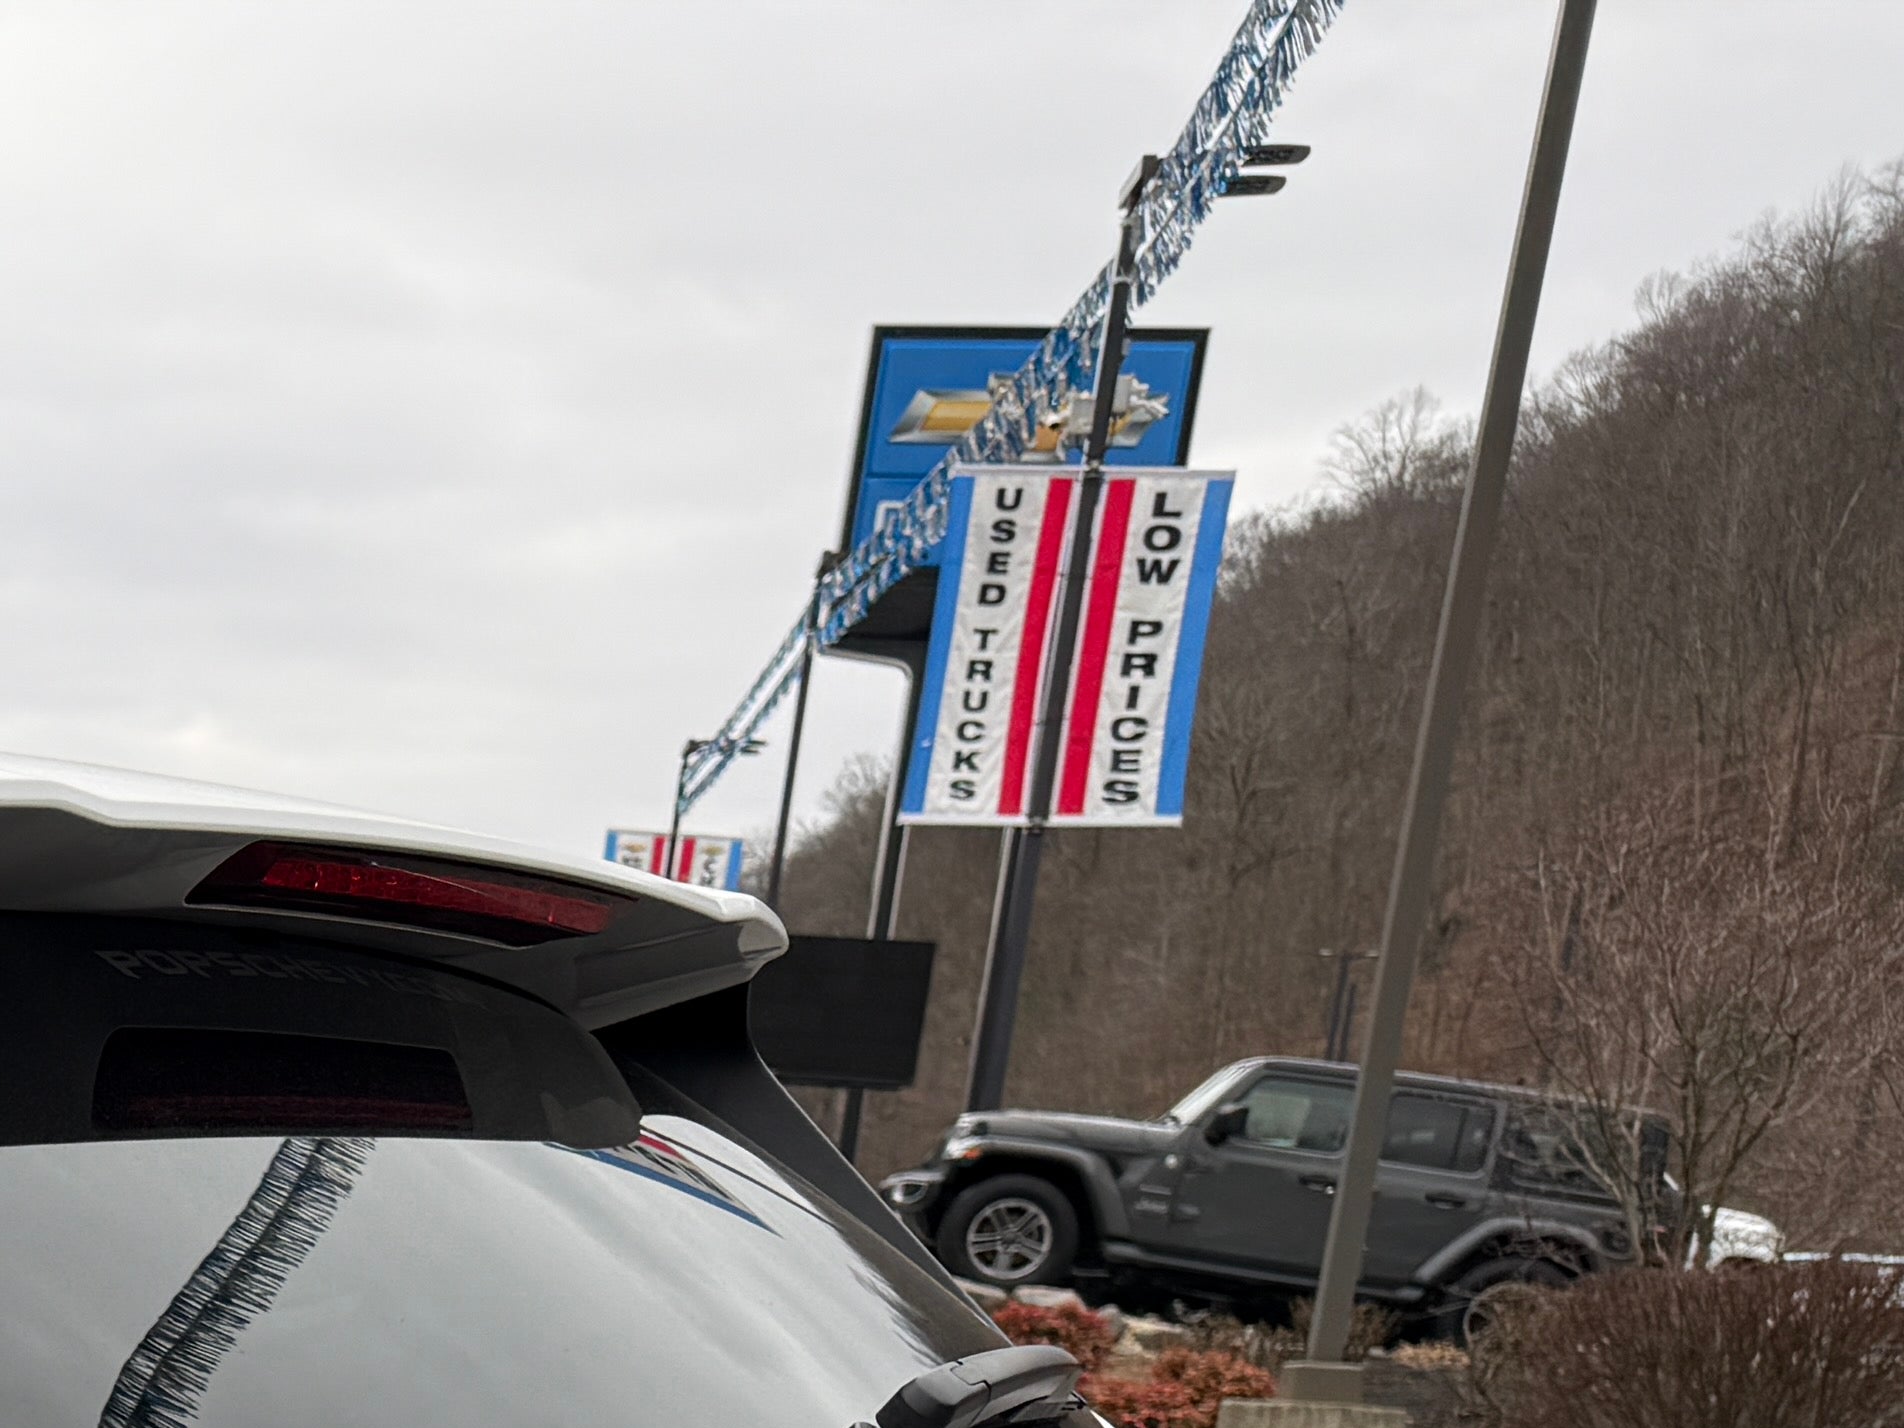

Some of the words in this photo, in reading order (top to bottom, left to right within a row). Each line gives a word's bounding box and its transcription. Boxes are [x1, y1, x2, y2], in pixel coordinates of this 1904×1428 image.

[976, 486, 1025, 607] USED
[1135, 489, 1183, 586] LOW
[947, 627, 1000, 802] TRUCKS
[1101, 619, 1164, 806] PRICES
